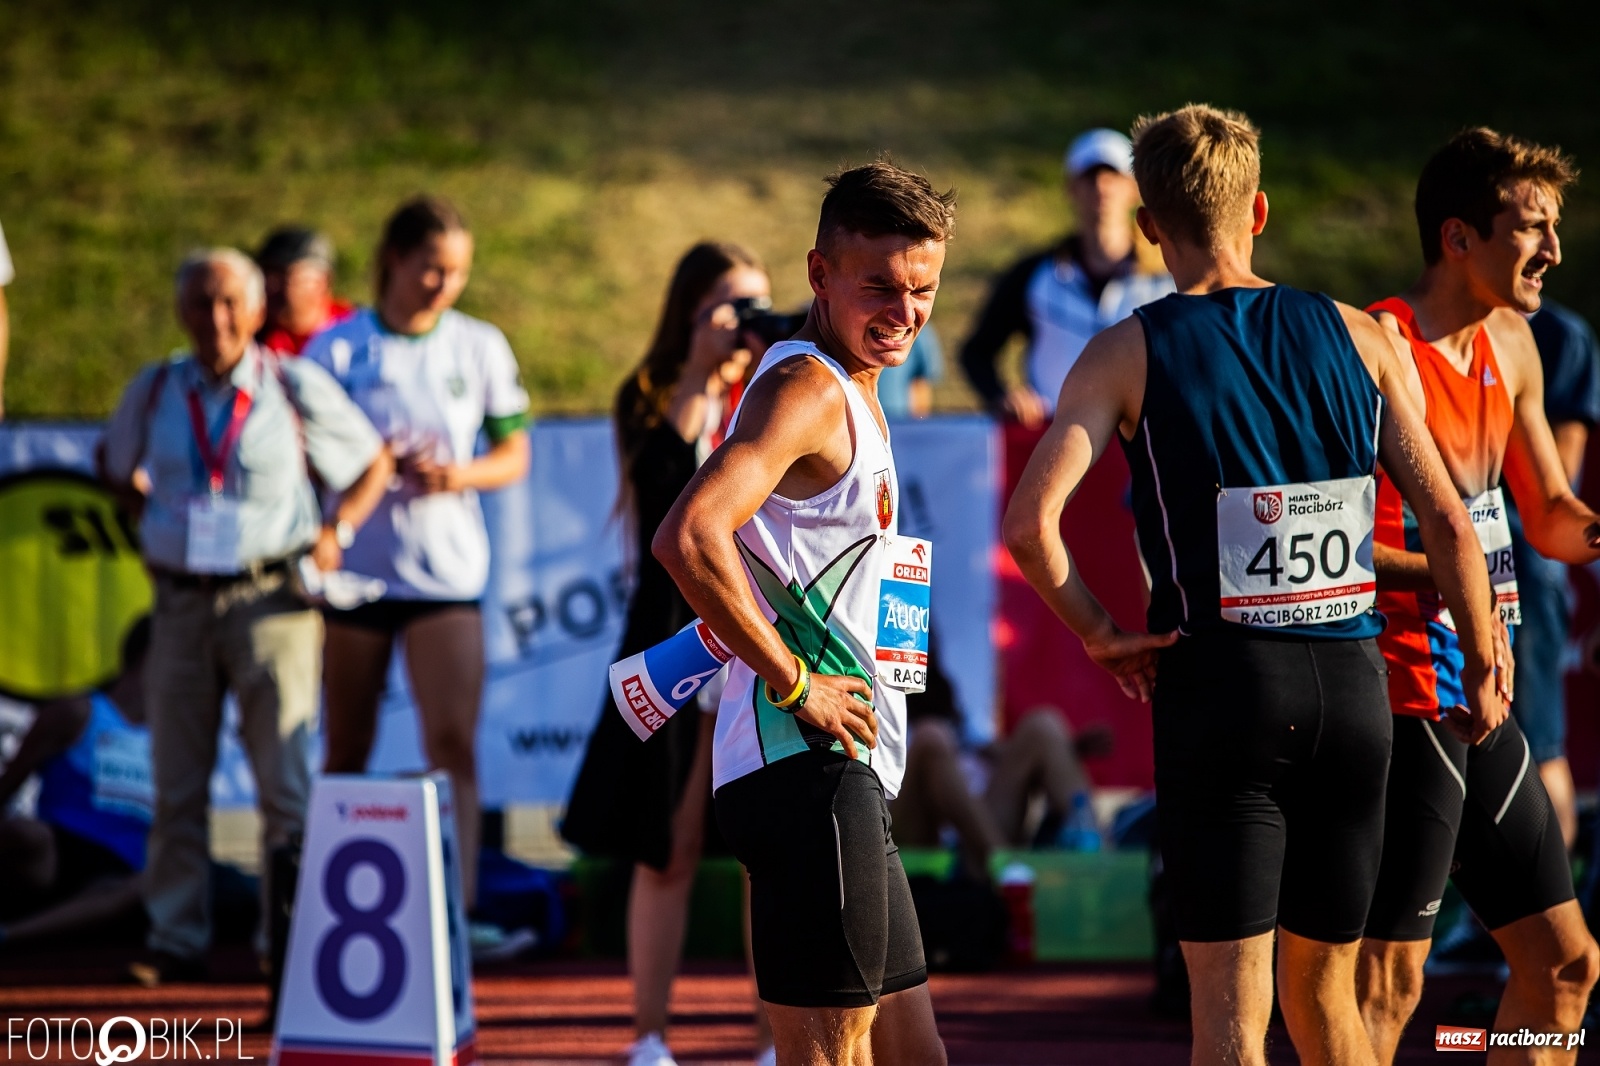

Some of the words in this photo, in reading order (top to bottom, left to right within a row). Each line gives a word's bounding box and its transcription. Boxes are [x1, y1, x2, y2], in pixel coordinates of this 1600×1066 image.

[1288, 493, 1320, 503] MIASTO
[1288, 499, 1344, 516] Racibórz
[1246, 529, 1350, 587] 450
[895, 566, 927, 581] ORLEN
[1272, 591, 1323, 603] MISTRZOSTWA
[1323, 588, 1346, 597] POLSKI
[1240, 605, 1322, 624] RACIBÓRZ
[1326, 601, 1358, 618] 2019
[624, 680, 666, 731] ORLEN
[315, 837, 409, 1024] 8
